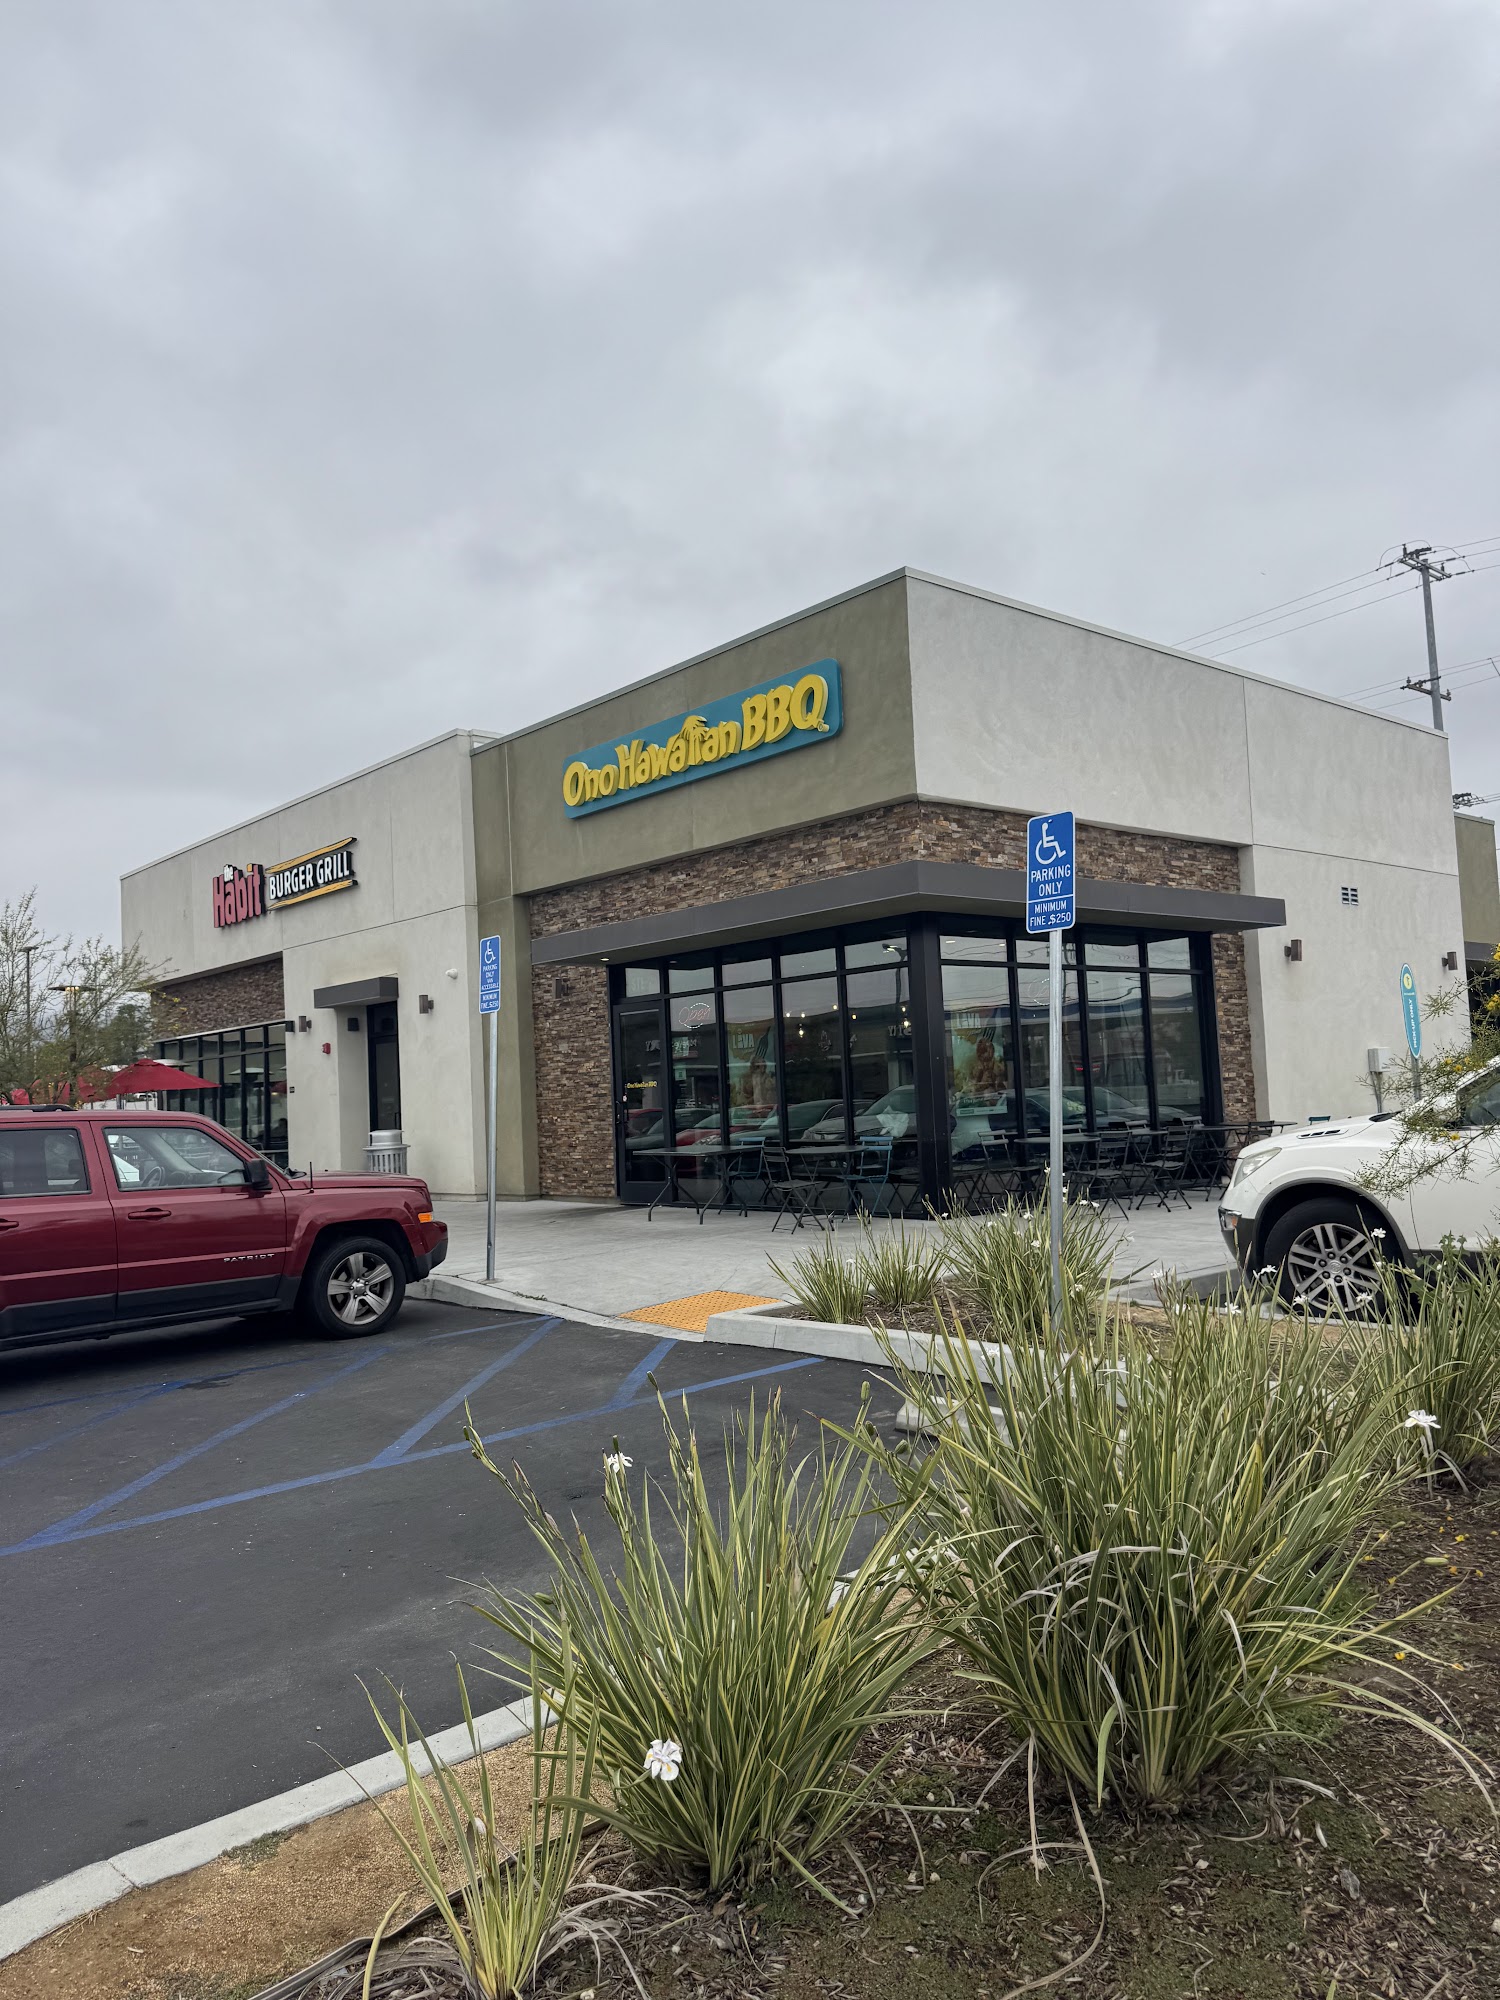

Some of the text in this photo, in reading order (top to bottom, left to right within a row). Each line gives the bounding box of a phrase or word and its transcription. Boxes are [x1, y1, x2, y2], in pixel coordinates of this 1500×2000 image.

[563, 674, 830, 806] Ono Hawaiian BBQ
[223, 864, 234, 882] the
[269, 851, 350, 900] BURGER GRILL
[1031, 864, 1071, 883] PARKING
[213, 863, 264, 928] Habit
[1038, 880, 1063, 897] ONLY
[1034, 900, 1067, 914] MINIMUM
[1030, 911, 1071, 927] FINE $250
[1410, 1019, 1418, 1048] PICK-UP
[223, 1253, 275, 1263] PATRIOT
